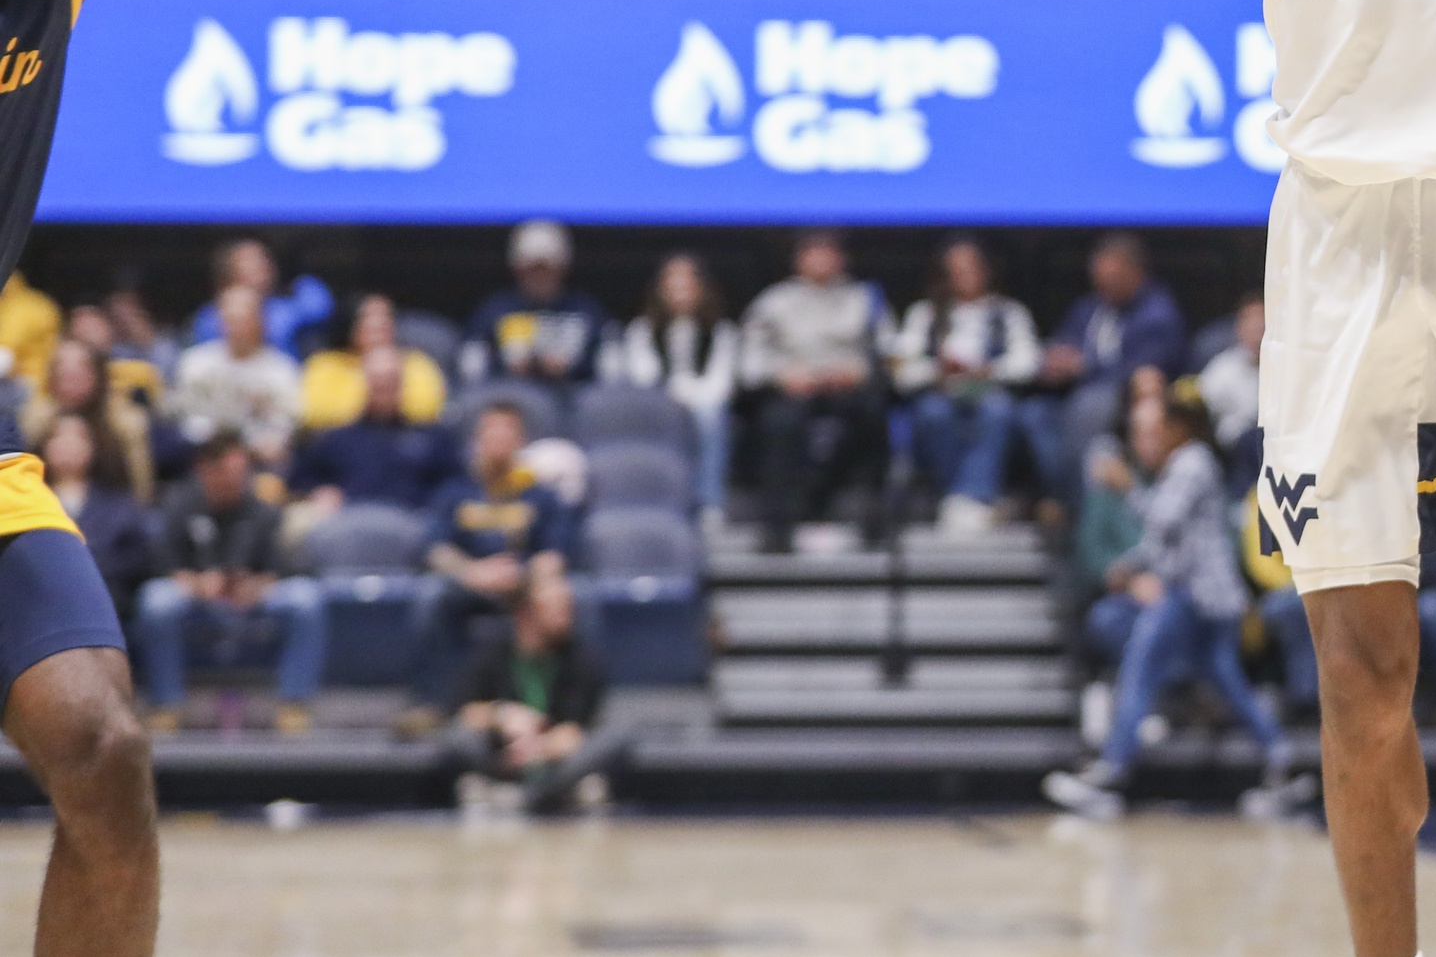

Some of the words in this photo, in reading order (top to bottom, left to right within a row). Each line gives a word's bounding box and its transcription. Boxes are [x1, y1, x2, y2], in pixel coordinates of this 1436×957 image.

[268, 16, 516, 110] Hope
[754, 20, 998, 111] Hope
[265, 92, 446, 171] Gas
[752, 95, 930, 173] Gas
